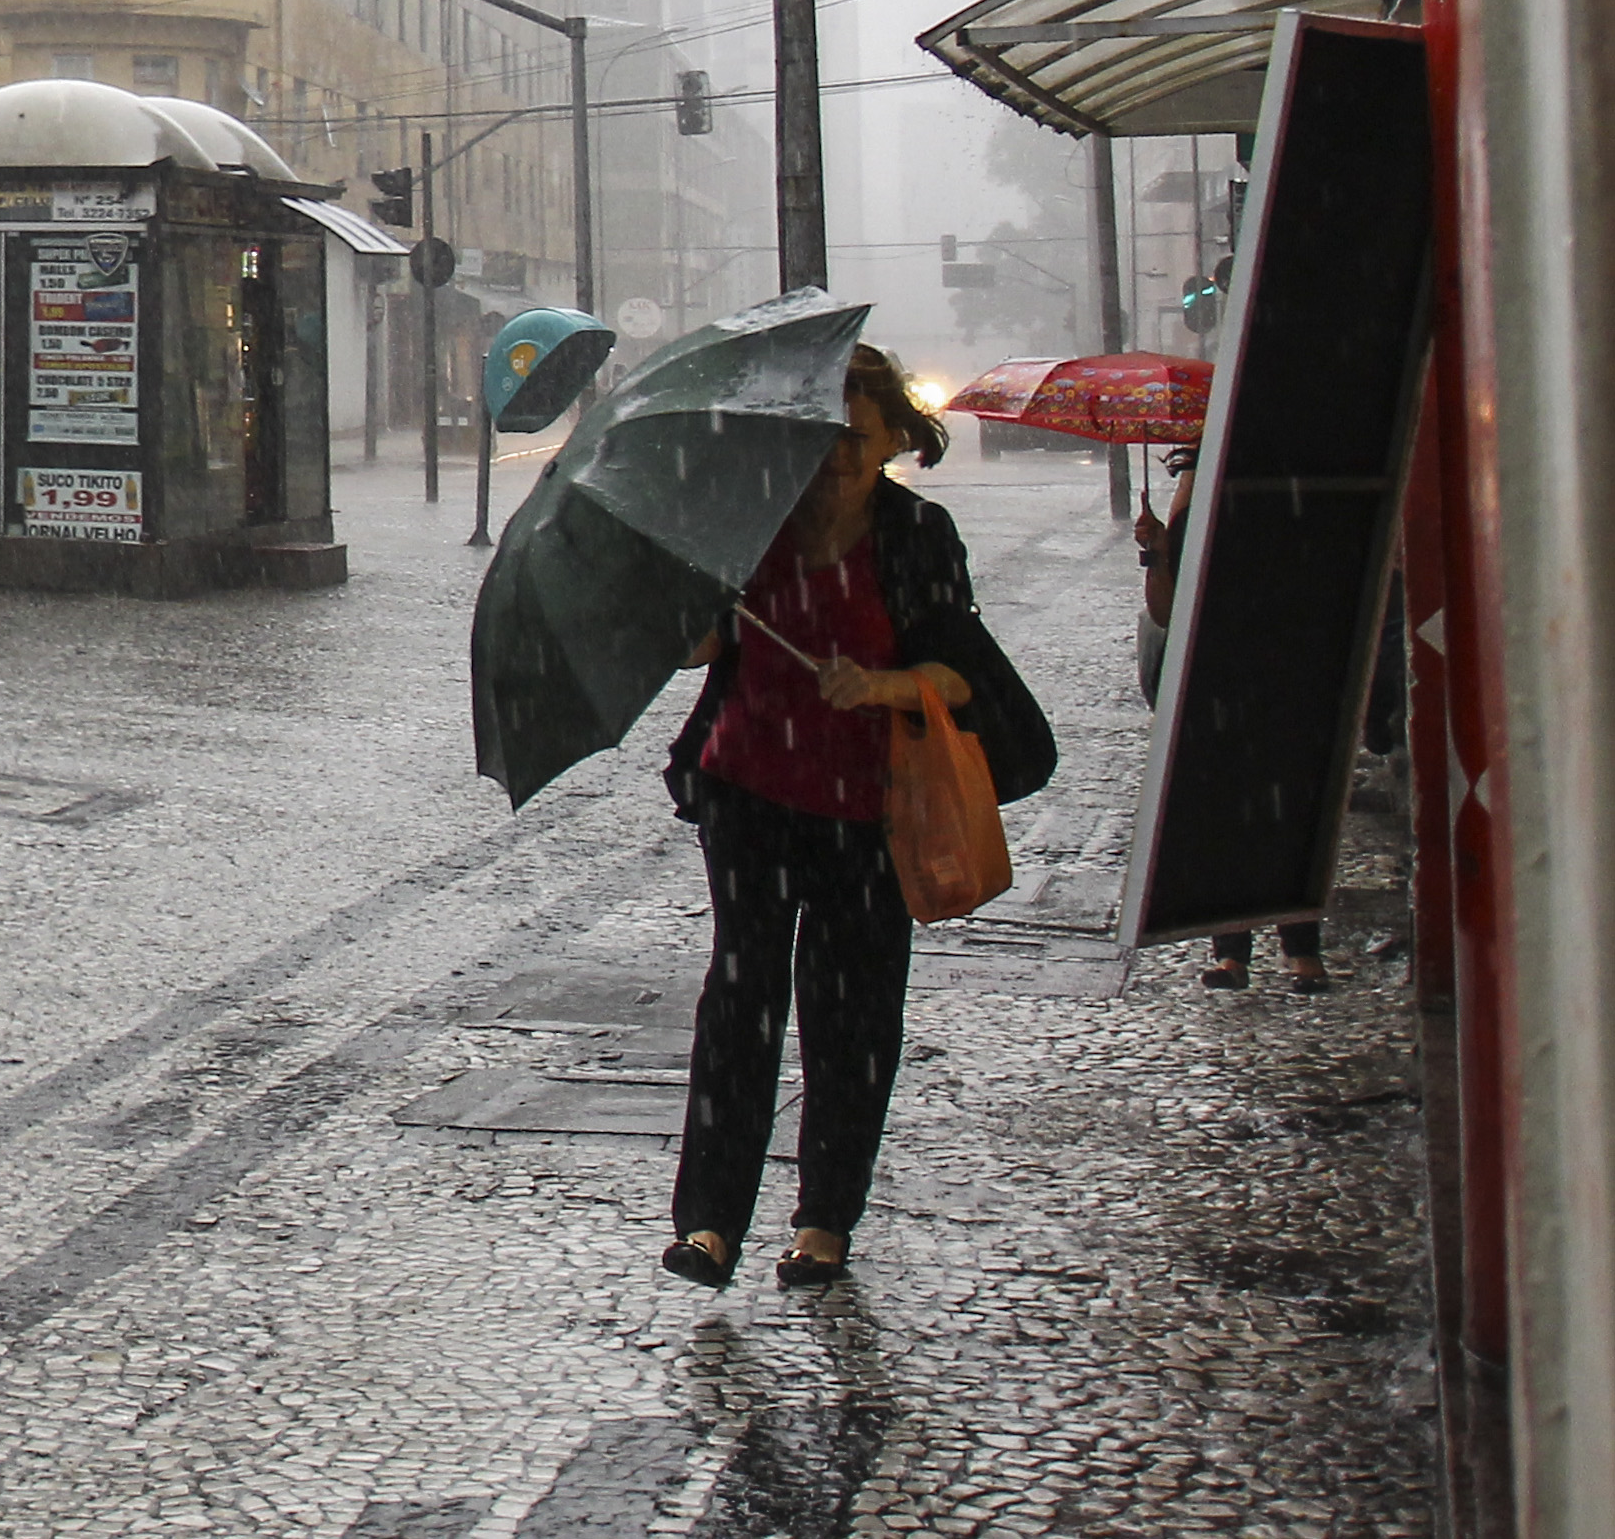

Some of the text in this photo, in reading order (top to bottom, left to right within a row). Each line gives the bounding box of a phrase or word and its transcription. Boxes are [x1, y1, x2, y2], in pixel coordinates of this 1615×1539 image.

[37, 474, 123, 490] SUCO TIKITO
[41, 490, 118, 509] 1,99
[26, 511, 136, 523] VENDEMOS
[84, 526, 137, 541] VELHO
